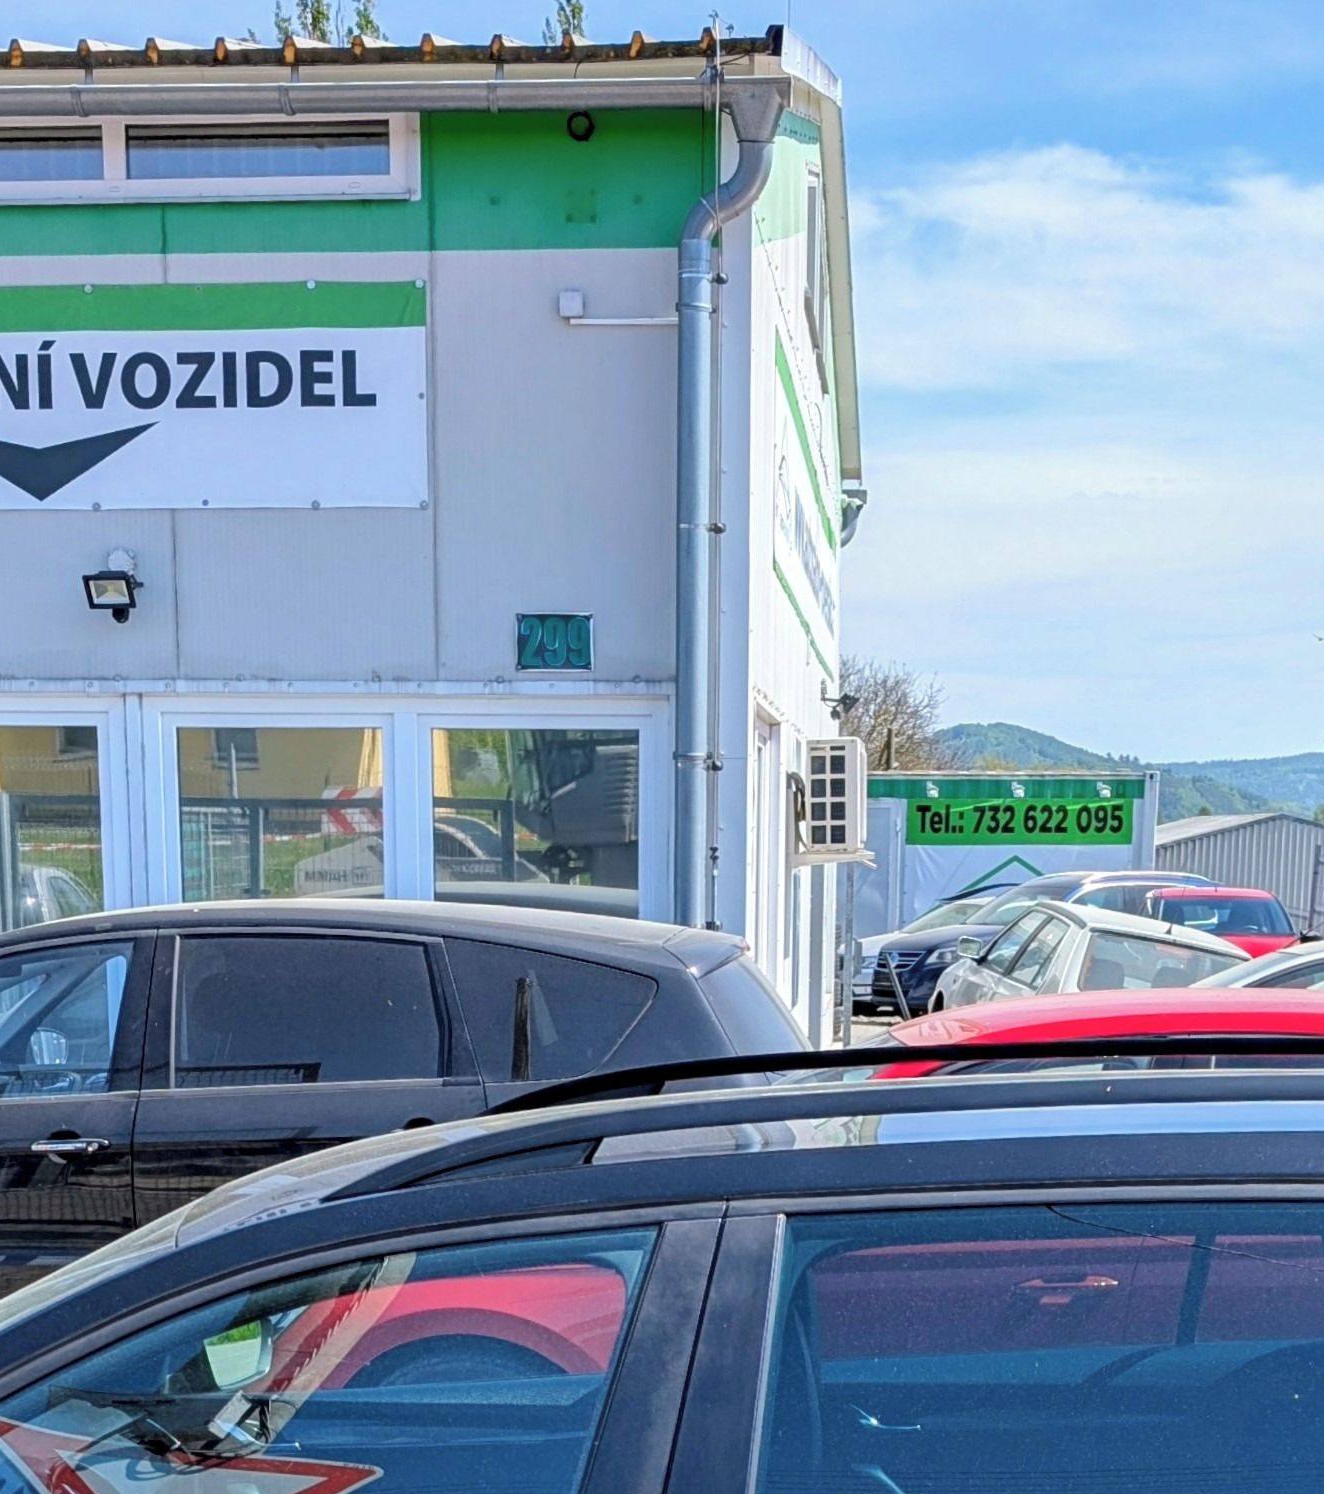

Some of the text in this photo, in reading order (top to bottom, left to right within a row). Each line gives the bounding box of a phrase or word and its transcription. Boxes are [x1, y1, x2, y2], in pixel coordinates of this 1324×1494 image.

[69, 350, 377, 410] VOZIDEL
[520, 616, 591, 666] 299
[915, 804, 1125, 834] Tel.: 732 622 095
